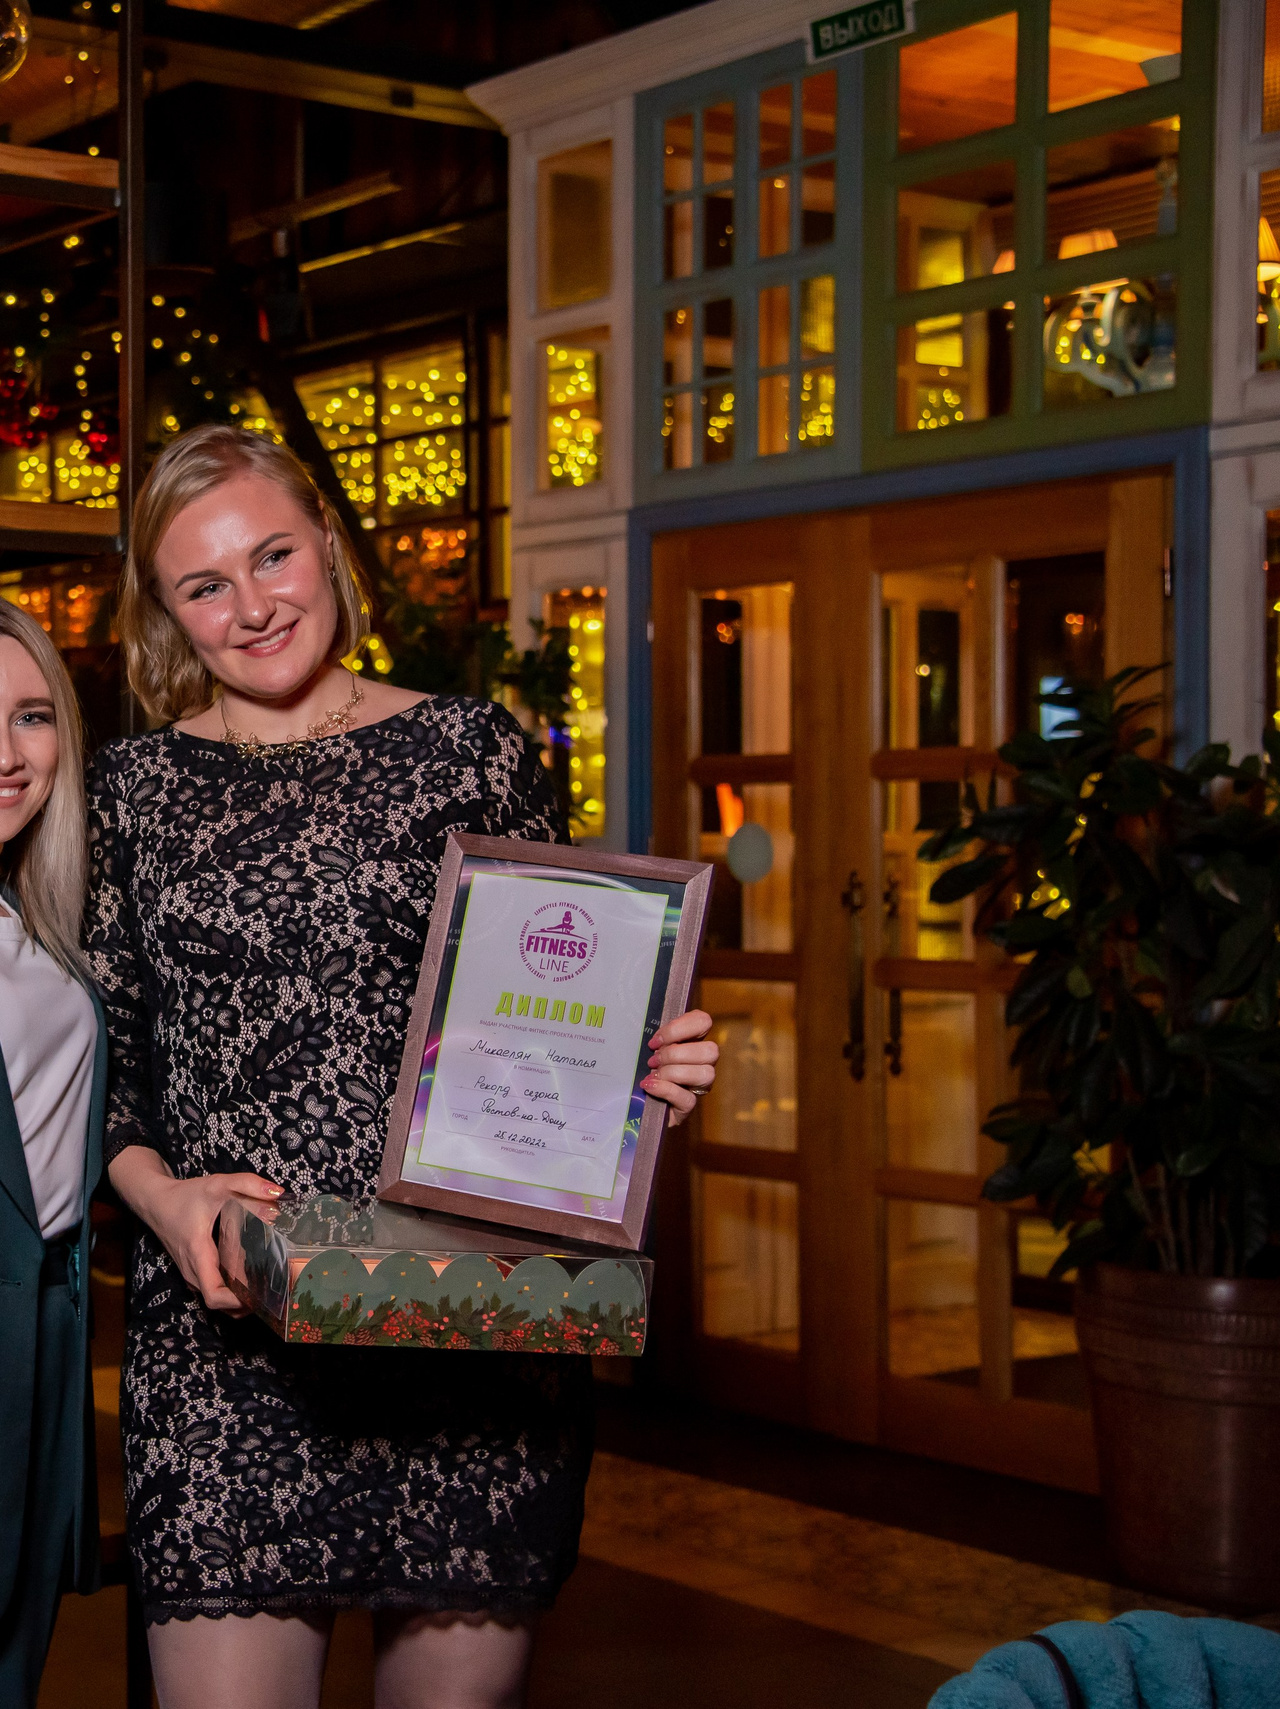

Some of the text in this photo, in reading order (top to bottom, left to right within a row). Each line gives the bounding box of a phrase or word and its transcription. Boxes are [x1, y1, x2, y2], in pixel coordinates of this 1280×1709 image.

[525, 935, 588, 960] FITNESS
[539, 957, 570, 974] LINE
[494, 991, 606, 1028] ДИПЛОМ
[479, 1019, 497, 1027] ВЫДАН
[498, 1022, 527, 1032] УЧАСТНИЦЕ
[544, 1048, 597, 1069] Наталья
[474, 1075, 560, 1102] Рекорд сезона
[452, 1112, 468, 1120] ГОРОД
